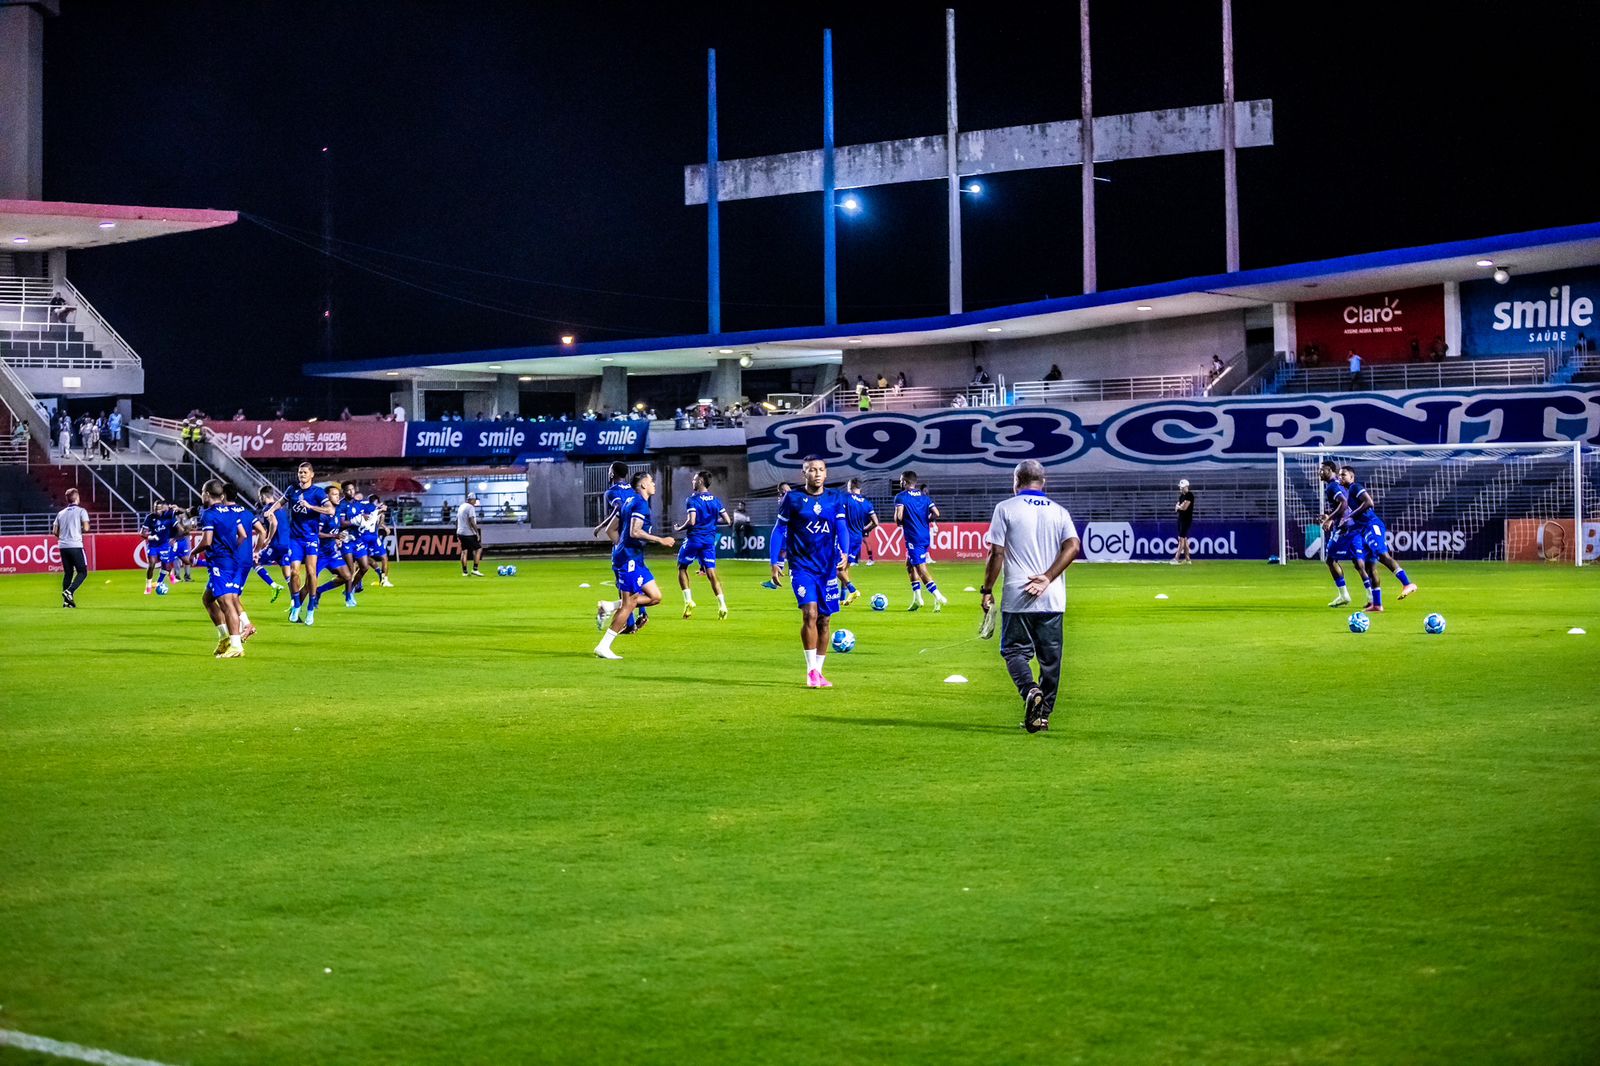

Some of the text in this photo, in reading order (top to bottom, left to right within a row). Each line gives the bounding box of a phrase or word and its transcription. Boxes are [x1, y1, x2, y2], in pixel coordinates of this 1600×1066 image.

[1343, 303, 1394, 324] Claro
[1492, 285, 1594, 331] smile
[1528, 330, 1567, 343] SAÚDE
[282, 432, 347, 442] ASSINE AGORA
[416, 426, 463, 447] smile
[478, 426, 525, 447] smile
[538, 426, 586, 446] smile
[597, 425, 637, 445] smile
[769, 394, 1600, 468] 1913 CENT
[281, 442, 347, 452] 0800 720 1234
[1023, 498, 1050, 506] VOLT
[805, 520, 831, 534] CSA
[1088, 528, 1130, 554] bet
